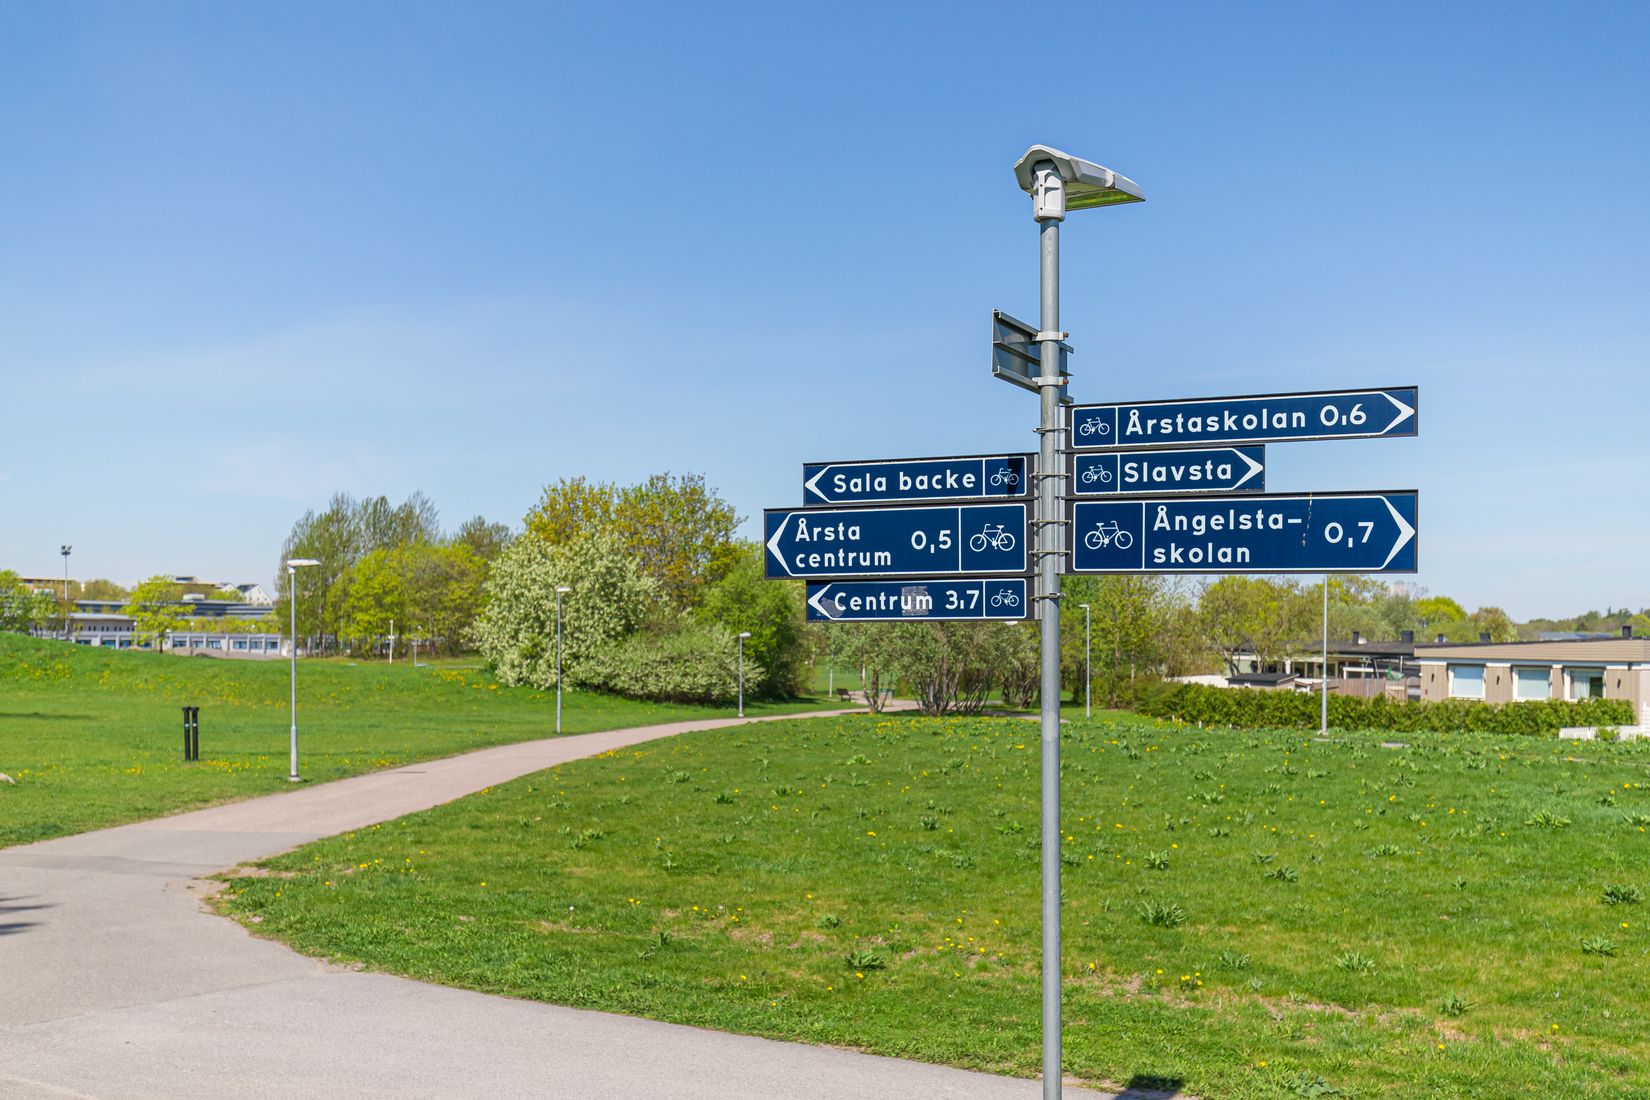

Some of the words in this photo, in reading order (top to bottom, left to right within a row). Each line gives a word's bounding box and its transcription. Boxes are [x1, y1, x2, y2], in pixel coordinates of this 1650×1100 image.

[1125, 409, 1306, 436] Årstaskolan
[833, 473, 888, 494] Sala
[899, 470, 977, 492] backe
[1124, 461, 1233, 483] Slavsta
[795, 518, 861, 542] Årsta
[1152, 505, 1302, 536] Ångelsta-
[911, 530, 952, 554] 0,5
[1324, 521, 1375, 548] 0,7
[795, 550, 892, 568] centrum
[1153, 543, 1251, 563] skolan
[833, 592, 933, 611] Centrum
